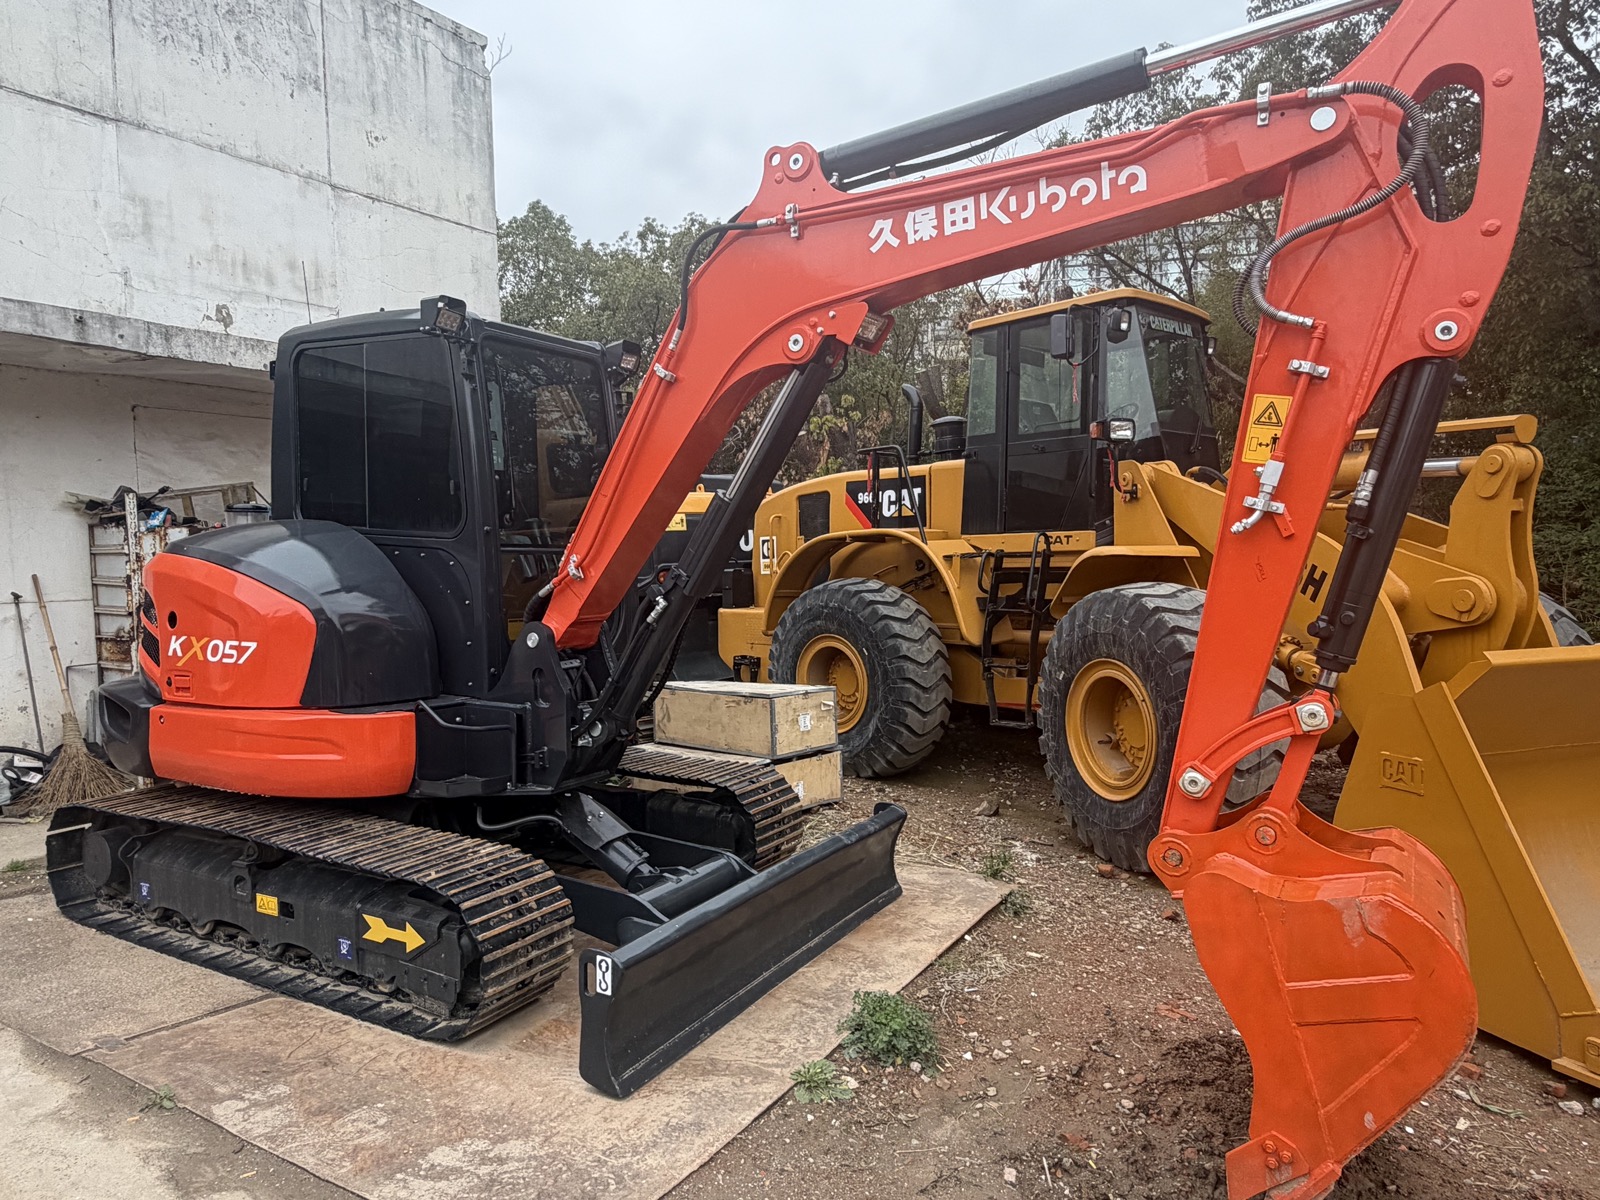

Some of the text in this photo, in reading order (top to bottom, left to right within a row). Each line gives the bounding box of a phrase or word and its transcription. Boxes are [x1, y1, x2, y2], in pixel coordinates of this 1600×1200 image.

[1149, 314, 1194, 338] CATERPILLAR
[167, 635, 258, 667] KX057
[1382, 758, 1418, 785] CAT
